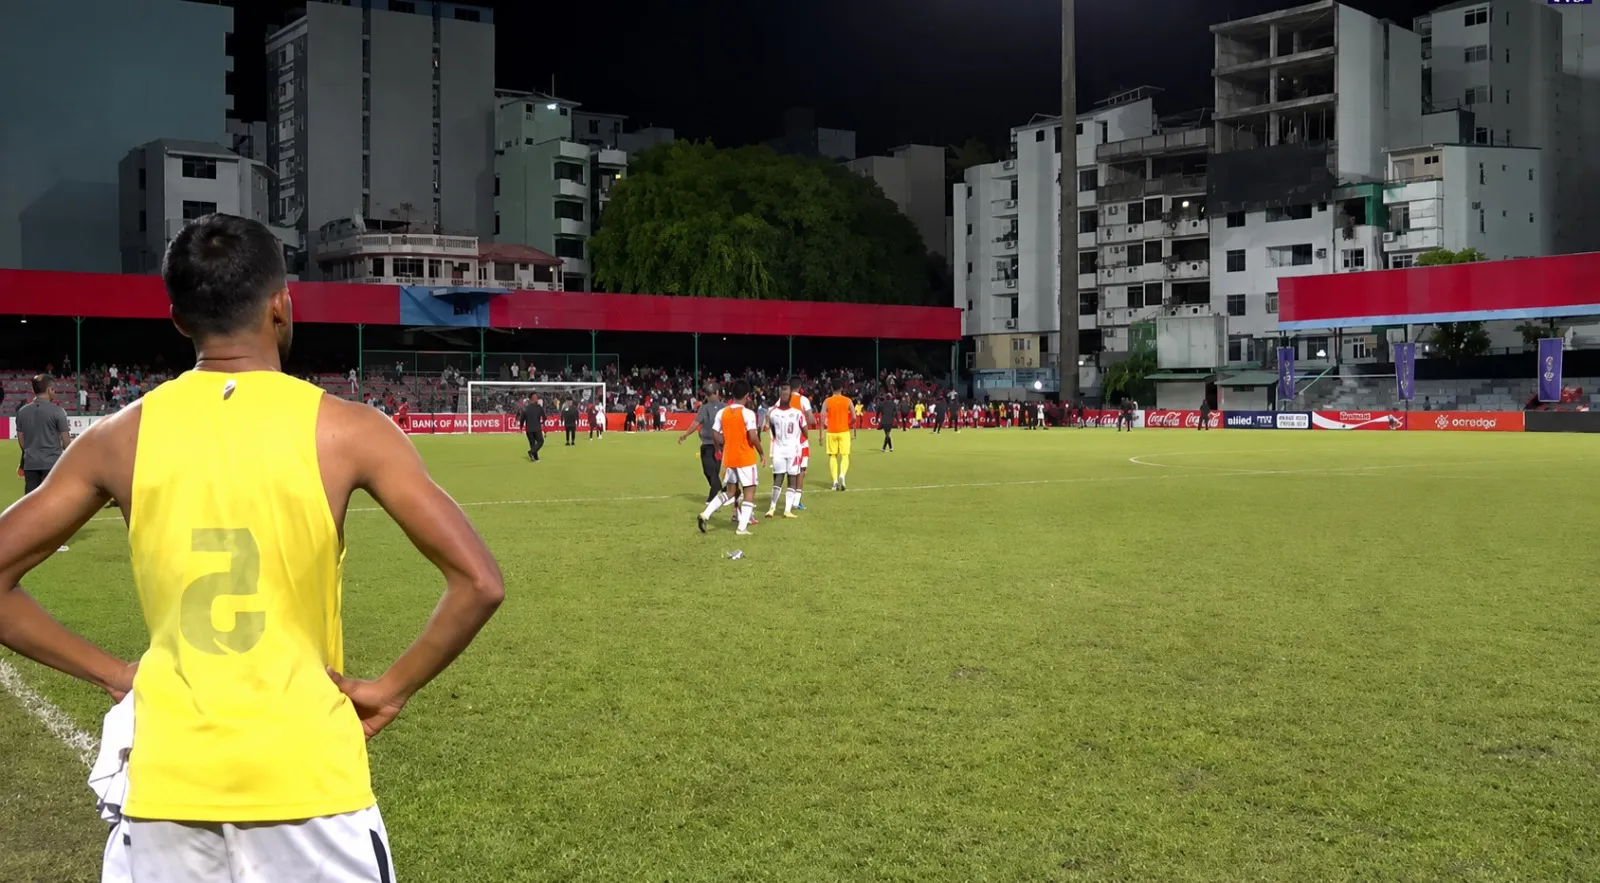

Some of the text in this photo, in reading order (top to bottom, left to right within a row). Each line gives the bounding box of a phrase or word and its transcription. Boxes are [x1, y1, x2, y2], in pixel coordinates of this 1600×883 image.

[412, 419, 500, 428] BANK OF MADIVES
